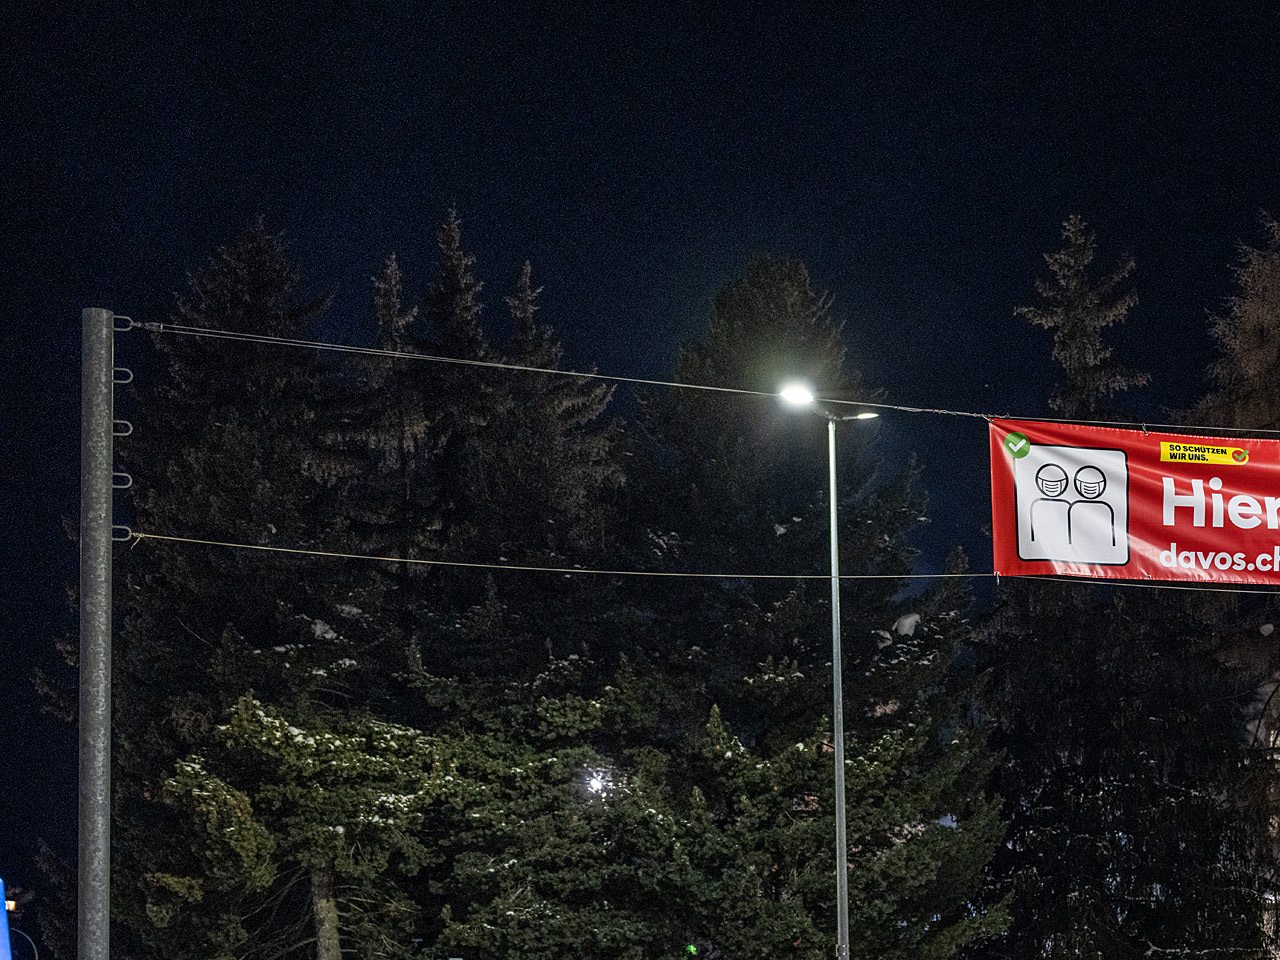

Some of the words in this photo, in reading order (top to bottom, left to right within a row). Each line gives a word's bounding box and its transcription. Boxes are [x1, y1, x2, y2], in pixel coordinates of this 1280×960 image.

[1169, 444, 1181, 452] SO
[1183, 445, 1227, 455] SCHÜTZEN
[1169, 452, 1186, 460] WIR
[1188, 453, 1209, 462] UNS.
